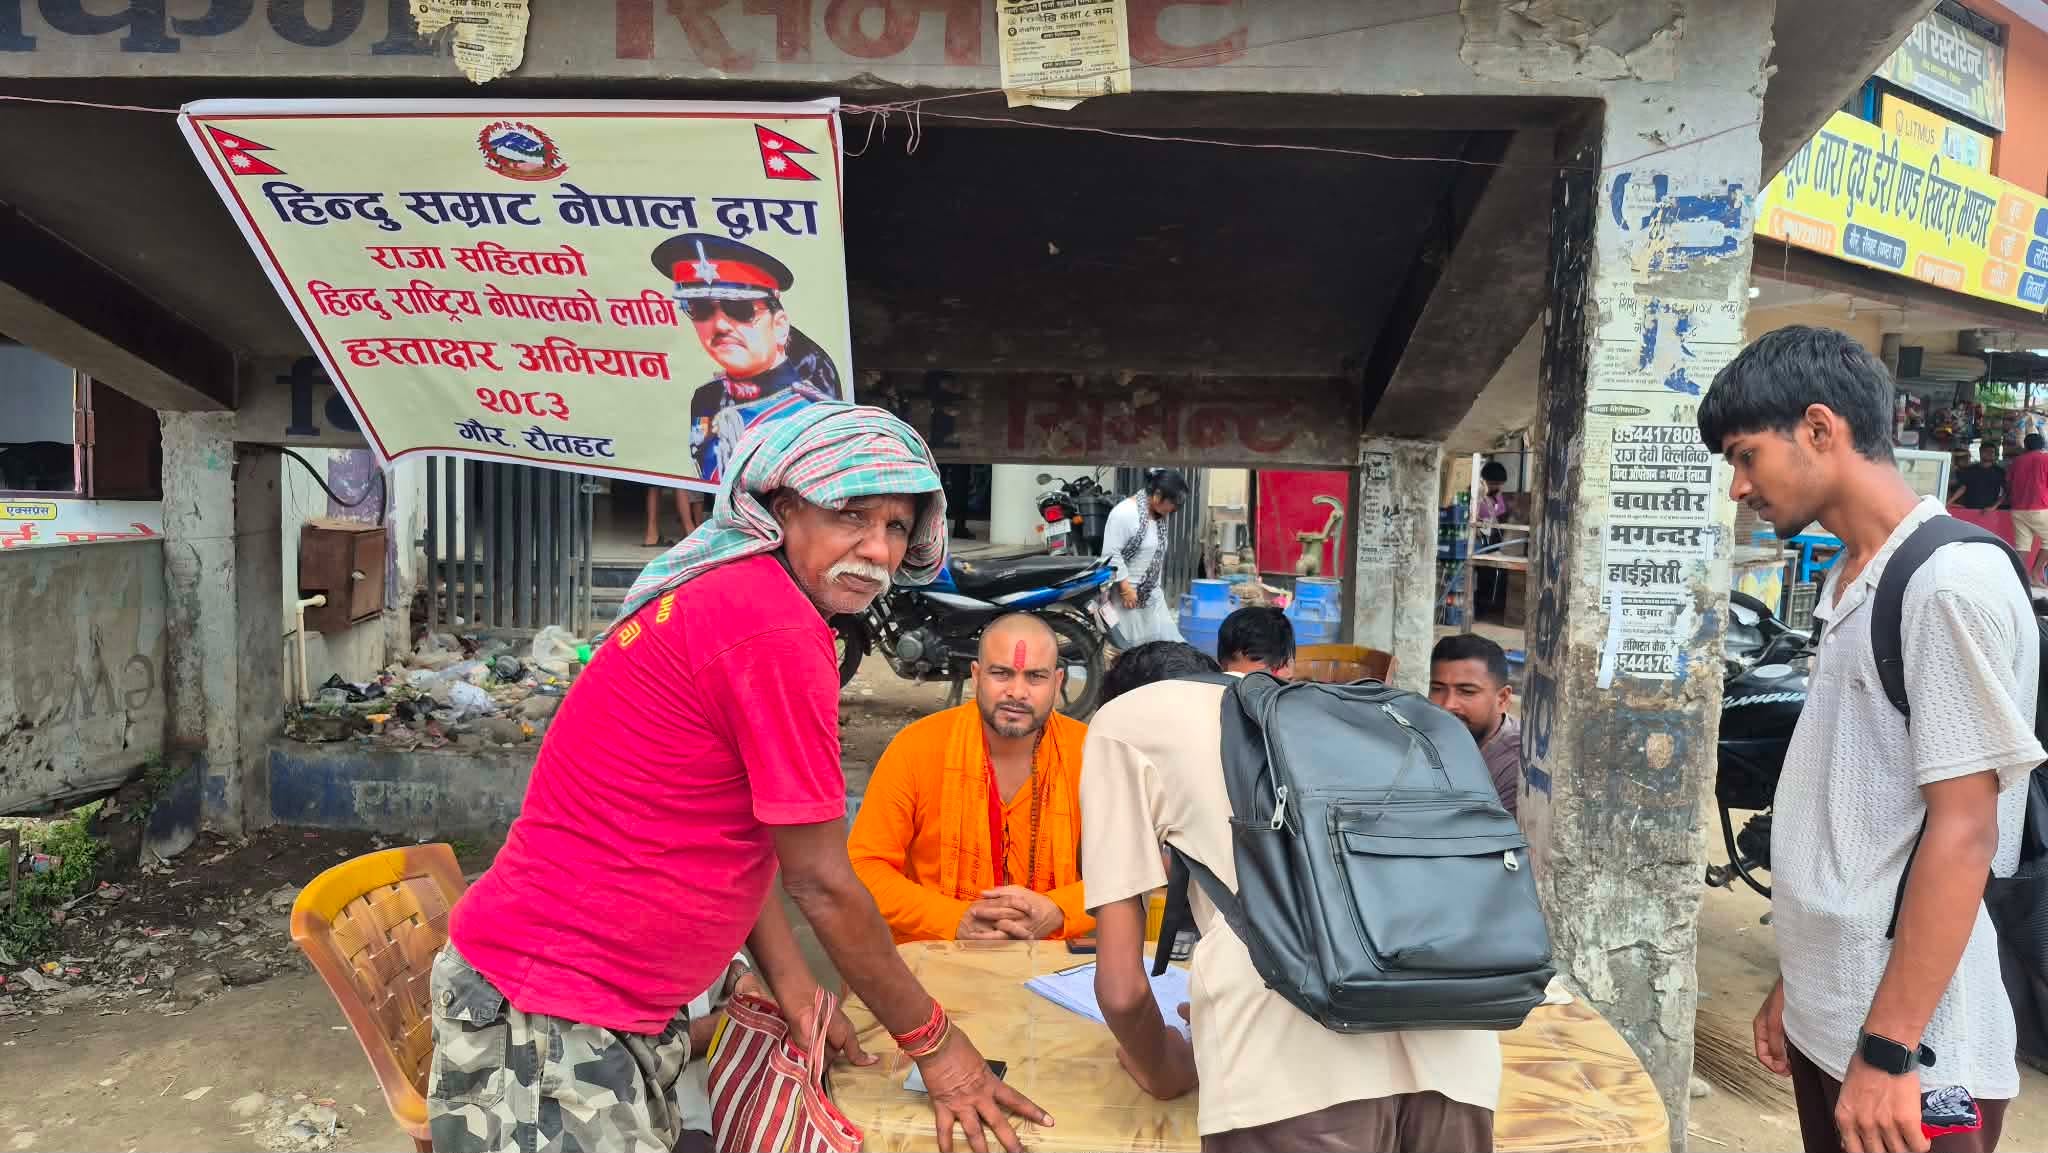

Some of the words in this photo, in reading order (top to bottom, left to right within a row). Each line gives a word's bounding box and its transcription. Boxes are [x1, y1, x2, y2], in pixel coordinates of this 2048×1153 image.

[1904, 121, 1936, 145] LITMUS
[262, 181, 402, 231] हिन्दु
[399, 191, 542, 229] सम्राट
[552, 183, 698, 229] नेपाल
[712, 197, 818, 239] द्वारा
[365, 246, 447, 270] राजा
[450, 240, 588, 277] सहितको
[307, 279, 393, 321] हिन्दु
[483, 283, 603, 324] नेपालको
[606, 289, 679, 327] लागि
[340, 337, 504, 371] हस्ताक्षर
[510, 336, 672, 381] अभियान
[475, 386, 571, 422] २०८३
[520, 425, 616, 458] रौतहट
[1614, 447, 1636, 463] राज
[1639, 445, 1658, 463] देवी
[1661, 445, 1710, 464] क्लिनिक
[1611, 487, 1709, 512] बवासीर
[1607, 558, 1683, 588] हाईड्रोसी
